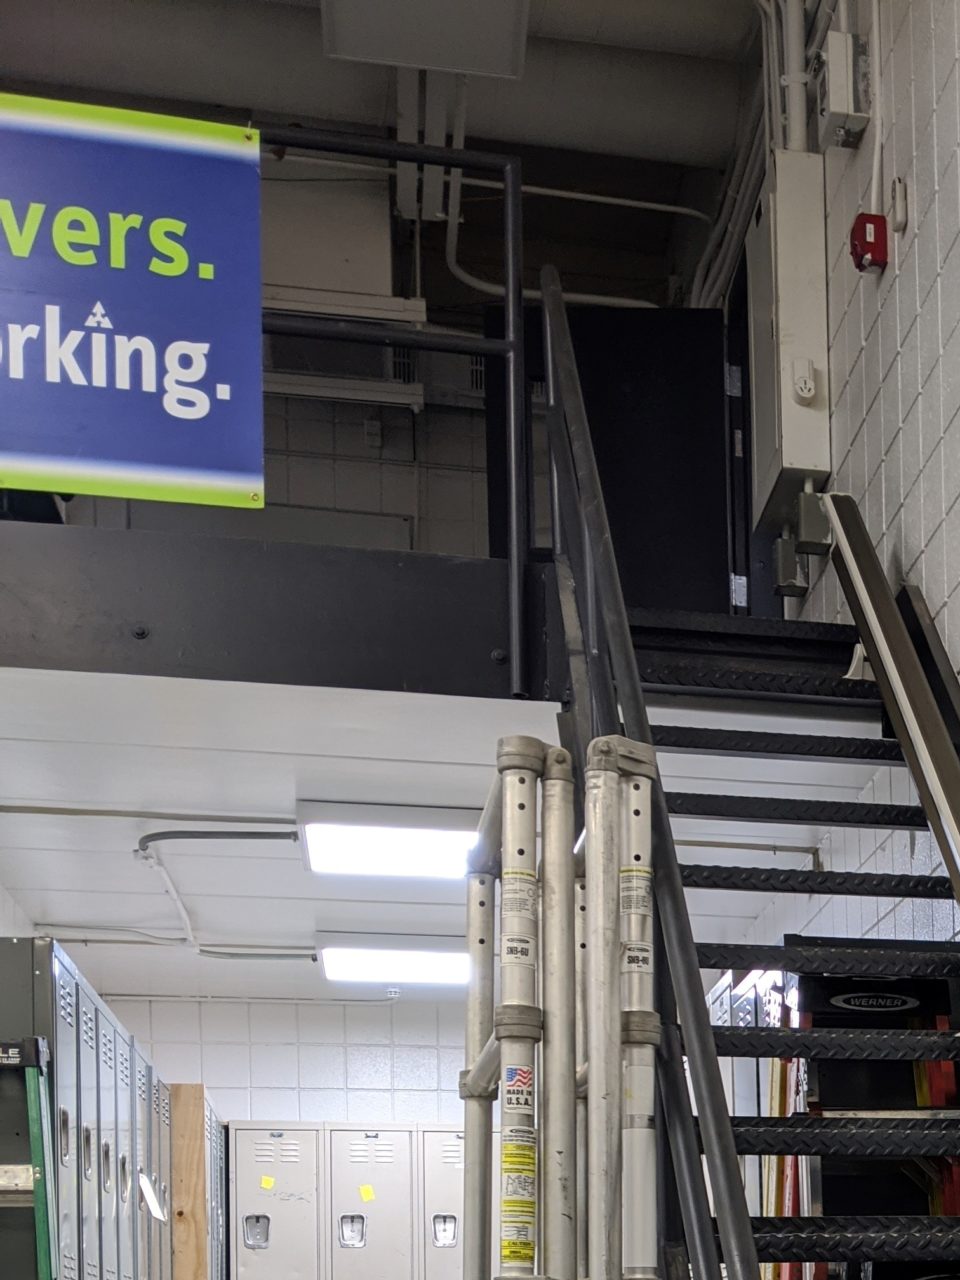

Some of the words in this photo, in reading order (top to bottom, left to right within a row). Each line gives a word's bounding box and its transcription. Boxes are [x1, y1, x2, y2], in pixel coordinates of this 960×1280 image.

[0, 198, 214, 280] vers.
[0, 300, 231, 419] rking.
[850, 998, 902, 1006] WERNER
